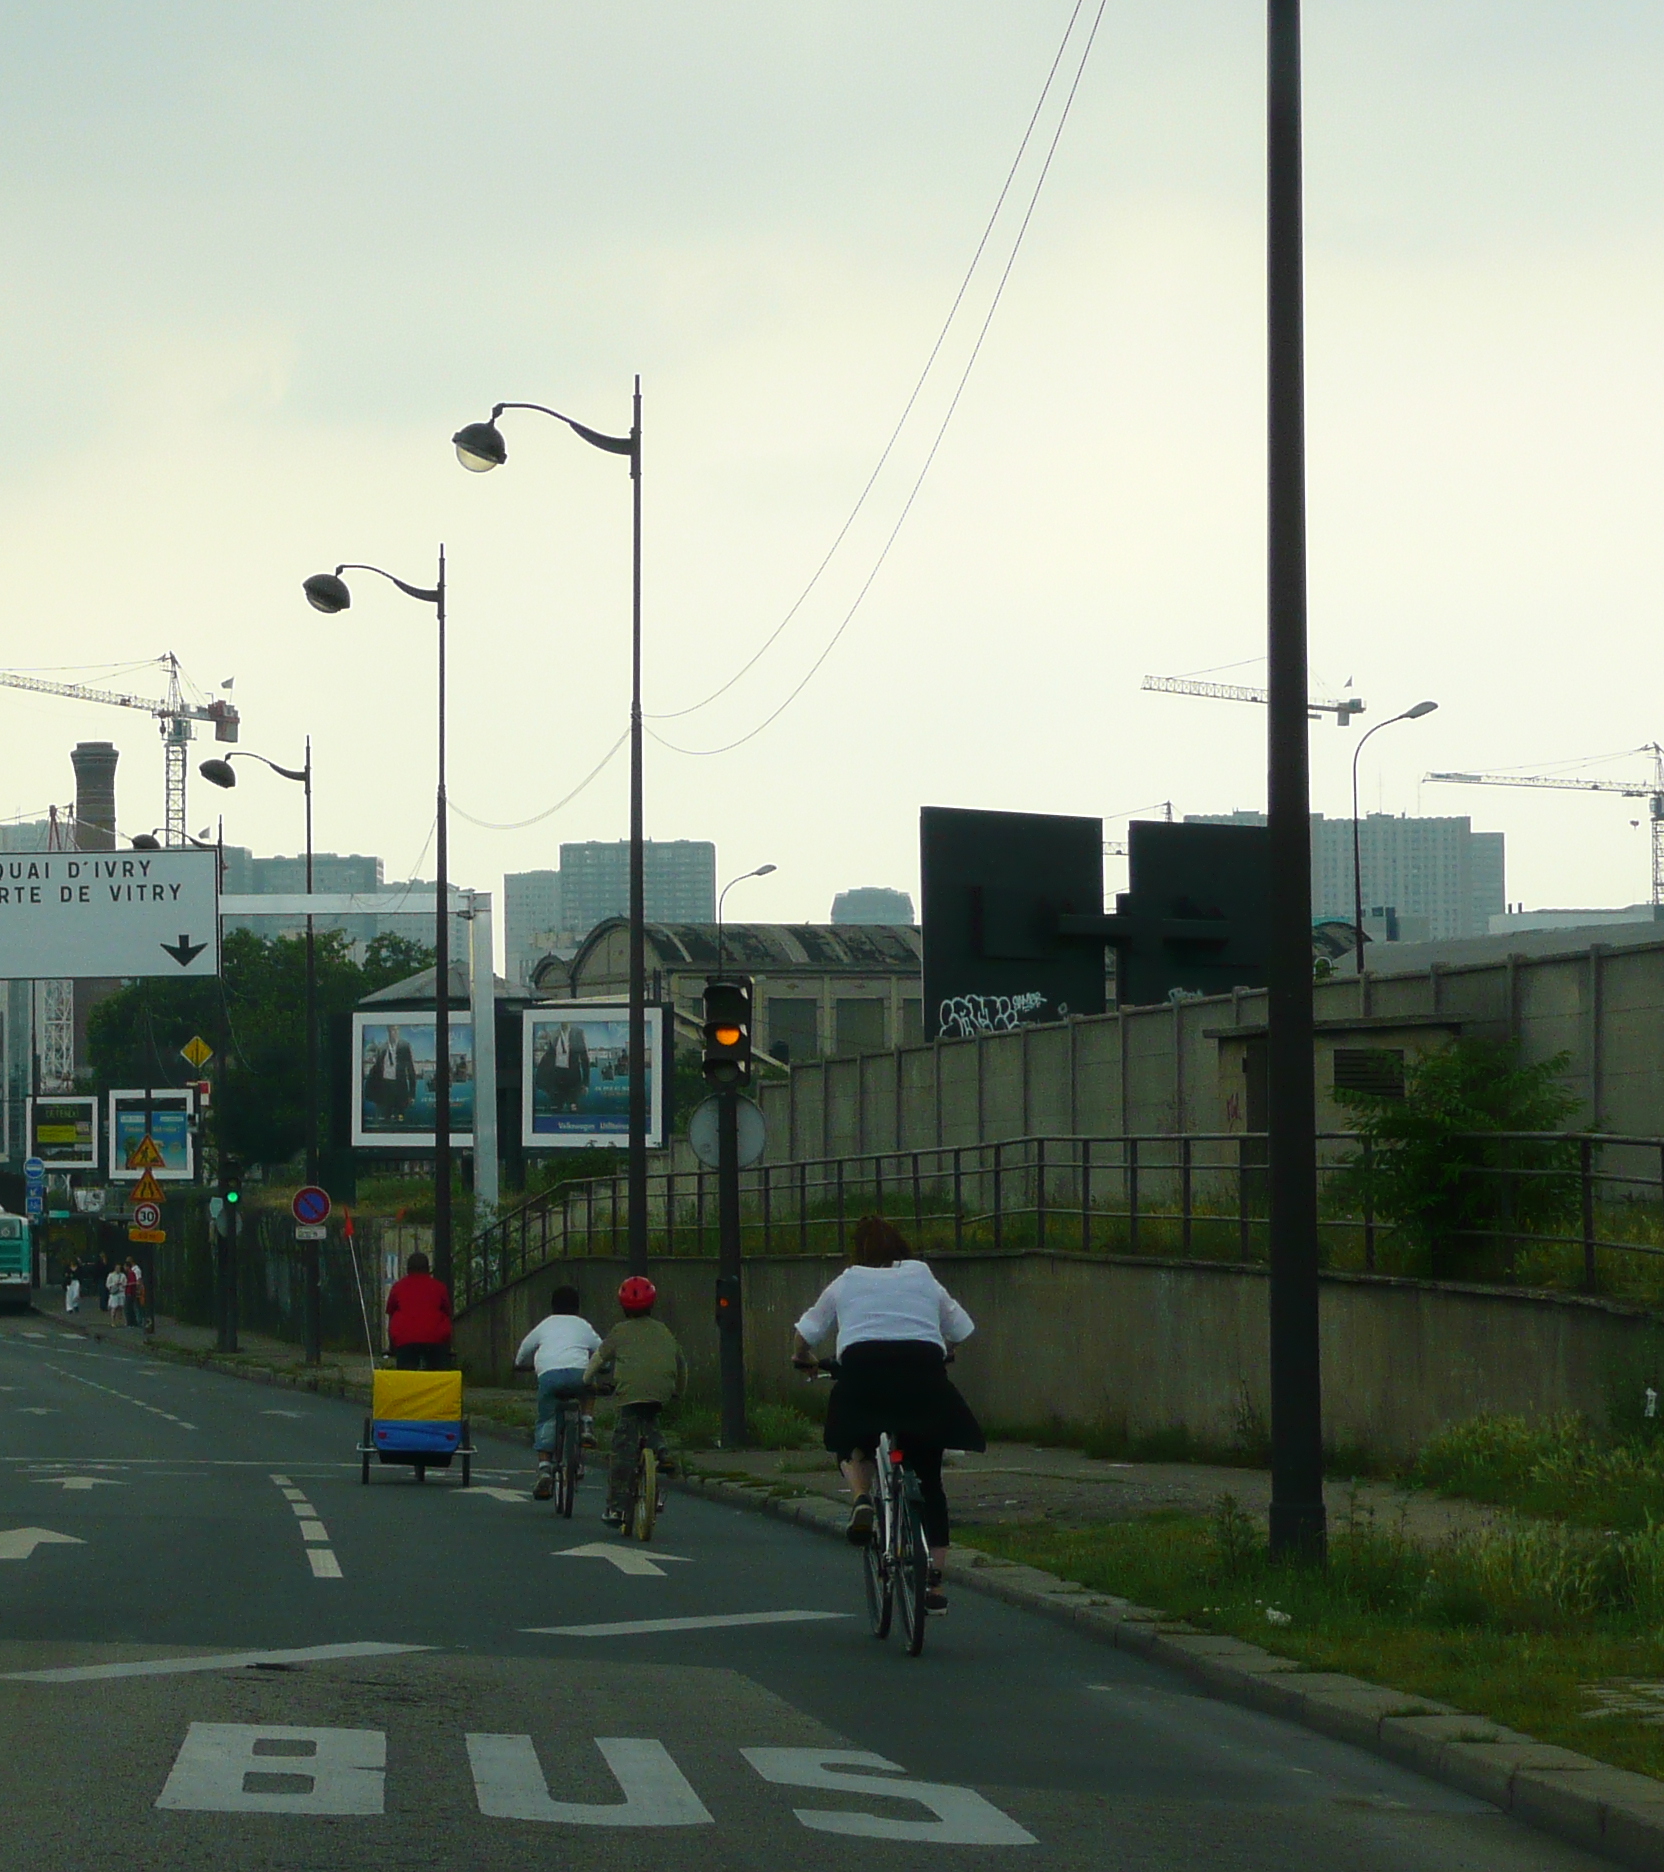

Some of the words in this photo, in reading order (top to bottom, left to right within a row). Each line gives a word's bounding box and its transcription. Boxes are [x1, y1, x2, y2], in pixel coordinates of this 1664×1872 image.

[68, 860, 150, 878] D'IVRY
[61, 886, 90, 902] DE
[109, 884, 181, 901] VITRY
[139, 1210, 155, 1222] 30
[153, 1721, 1040, 1849] BUS
